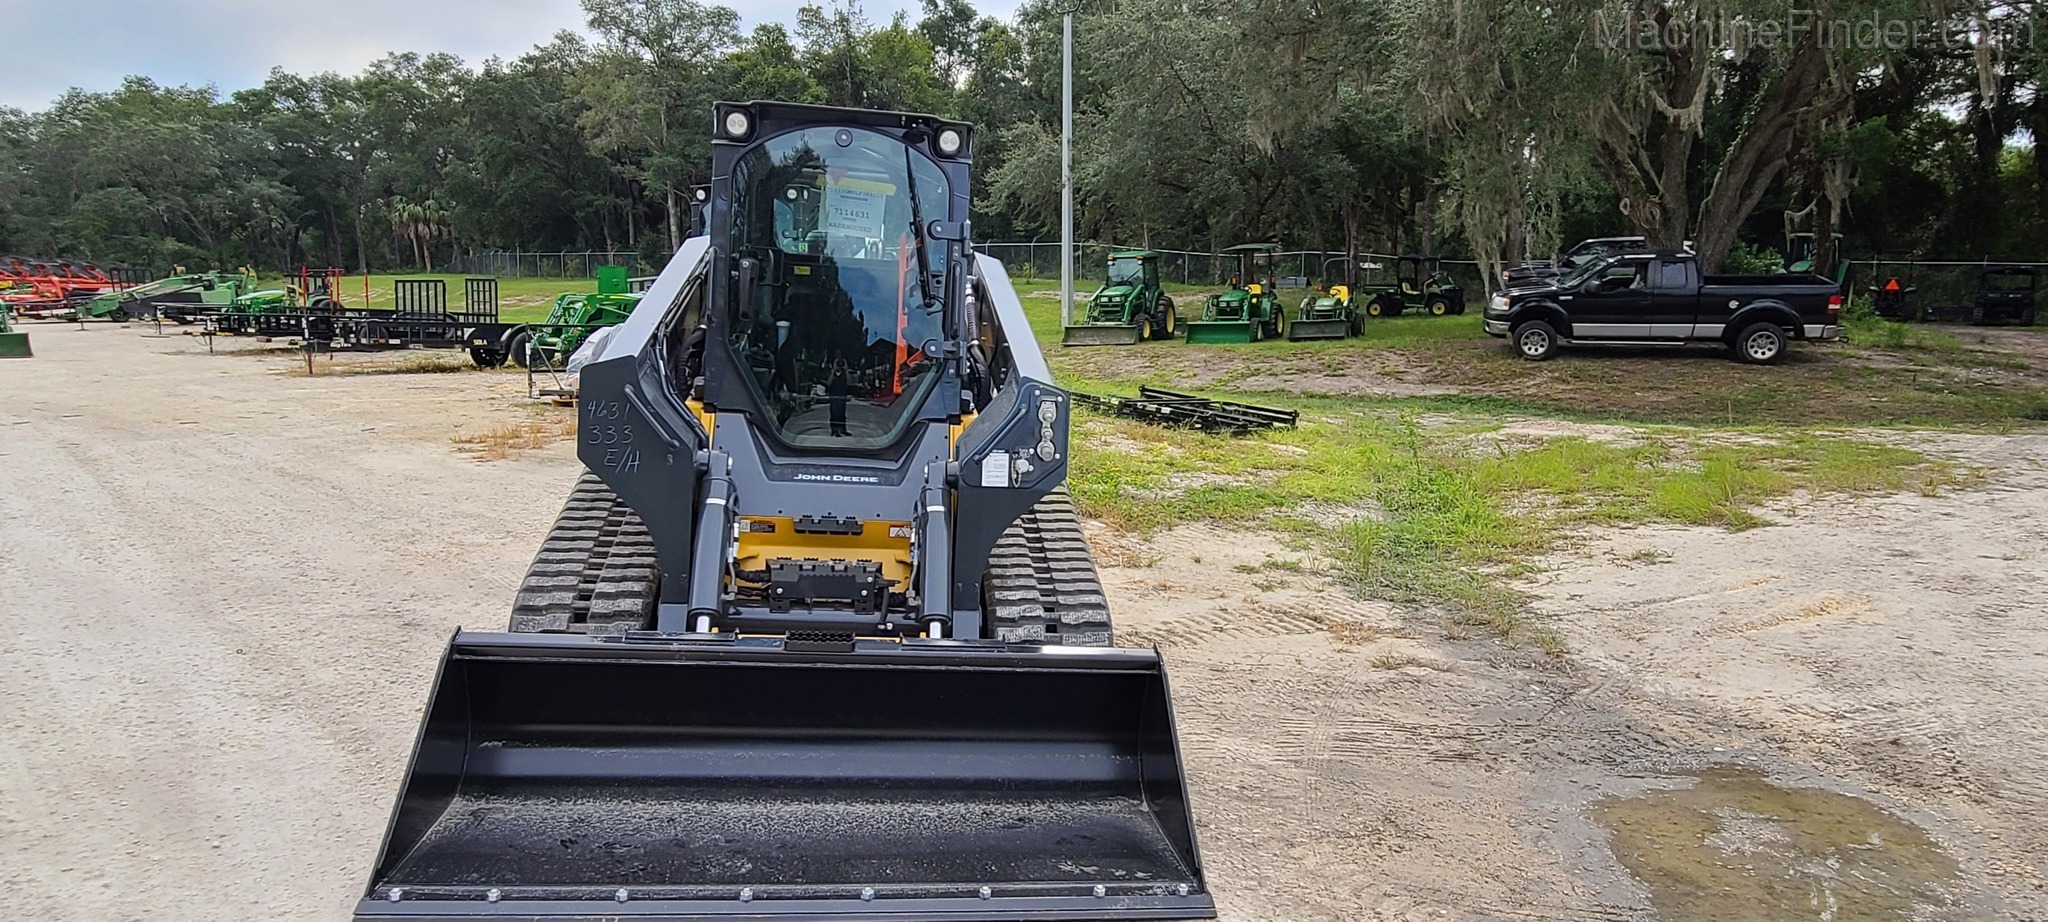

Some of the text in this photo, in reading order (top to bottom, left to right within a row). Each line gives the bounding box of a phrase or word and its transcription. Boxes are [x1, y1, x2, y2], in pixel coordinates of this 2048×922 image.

[833, 207, 870, 219] 7114631
[587, 400, 630, 420] 4631
[588, 425, 634, 444] 333
[604, 446, 640, 474] E/H
[793, 473, 879, 483] JOHN DEERE
